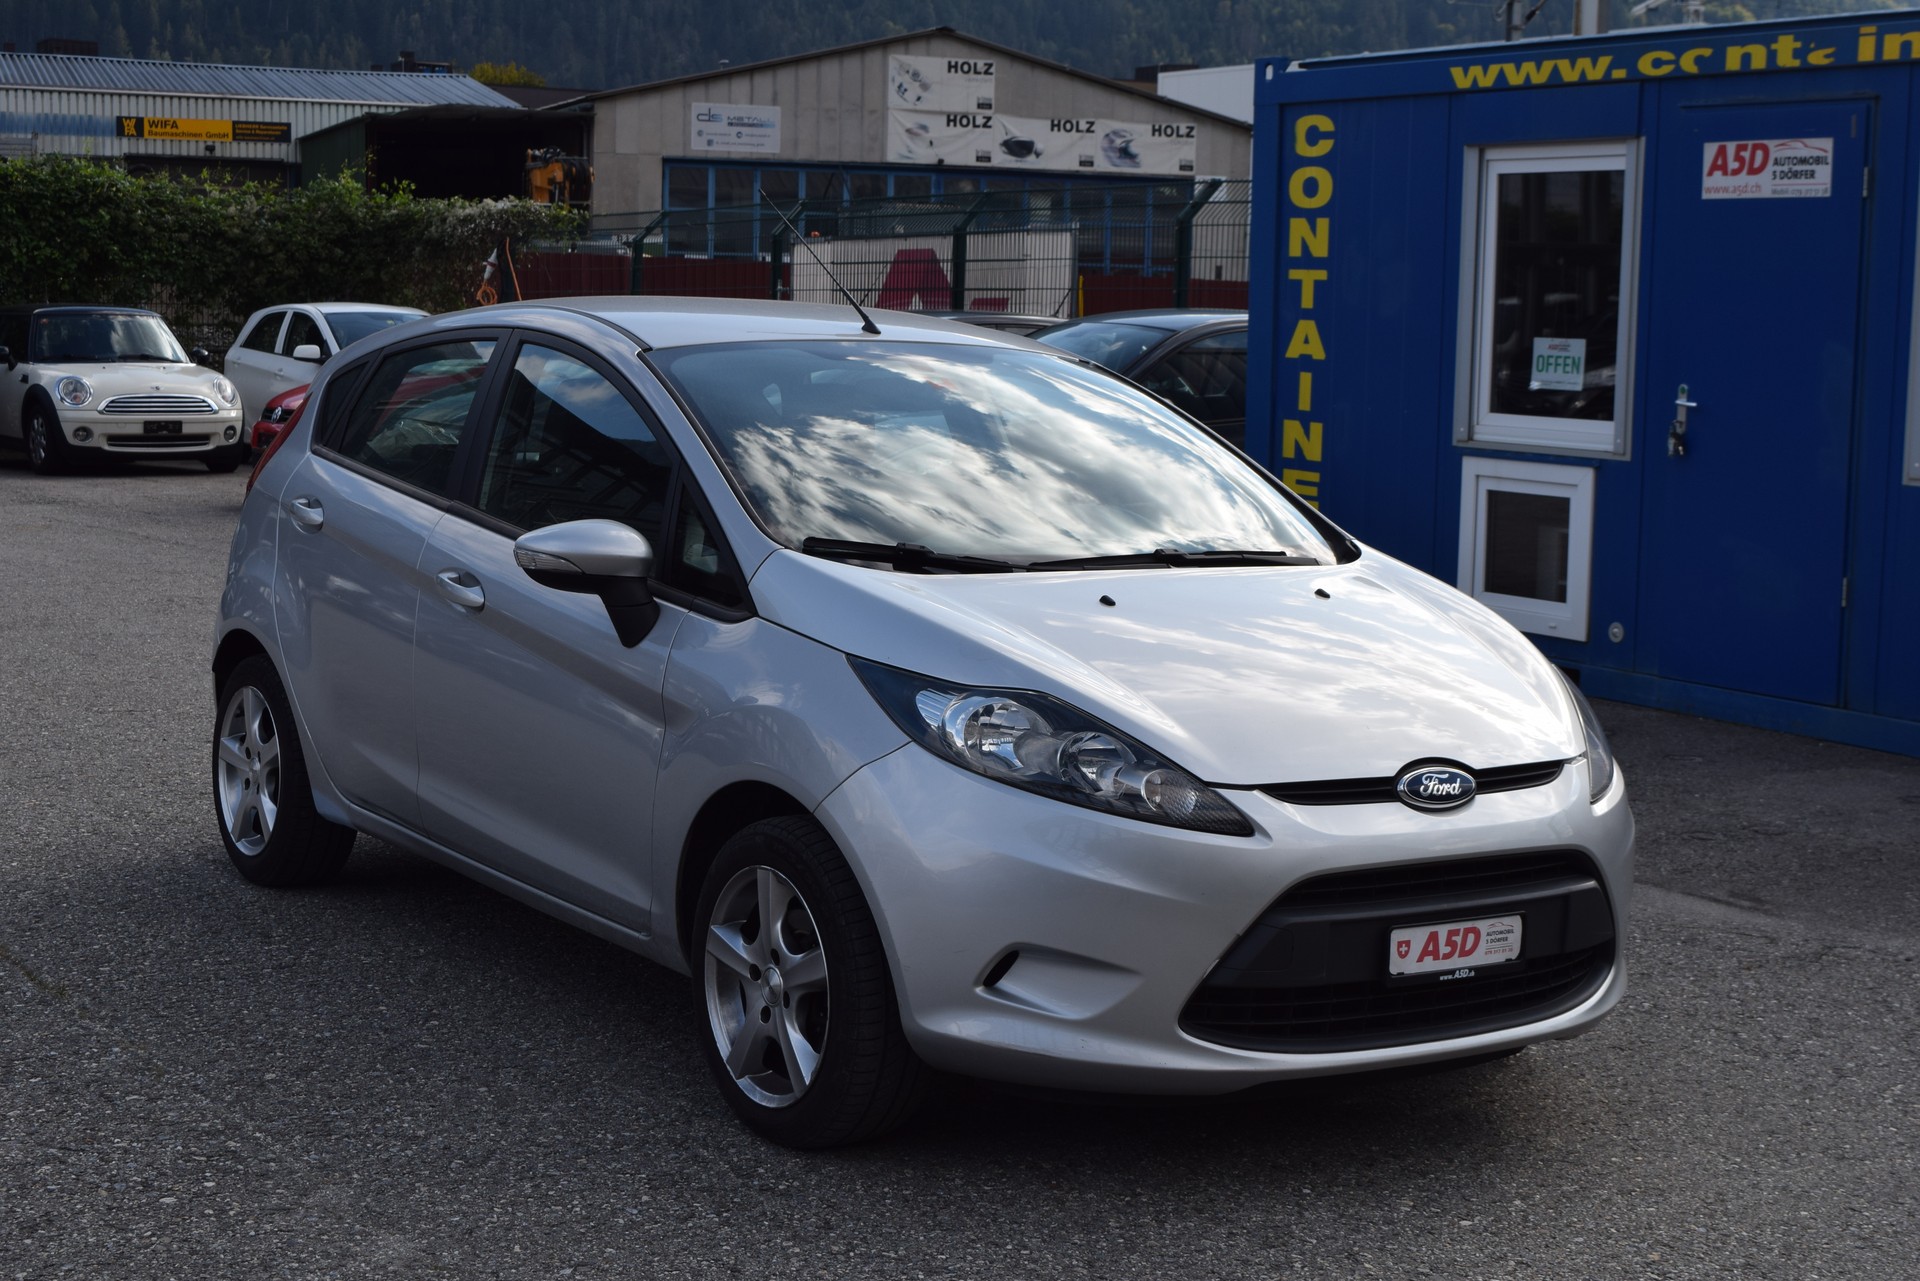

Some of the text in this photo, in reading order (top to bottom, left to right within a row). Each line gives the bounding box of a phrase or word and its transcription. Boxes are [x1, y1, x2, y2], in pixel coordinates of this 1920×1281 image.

[947, 61, 994, 75] HOLZ
[148, 119, 179, 129] WIFA
[946, 114, 993, 128] HOLZ
[1050, 119, 1096, 133] HOLZ
[148, 129, 203, 138] Baumaschinen
[205, 131, 229, 139] GmbH
[1151, 124, 1195, 138] HOLZ
[1706, 142, 1770, 177] A5D
[1772, 155, 1829, 167] AUTOMOBIL
[1779, 167, 1816, 180] DÖRFER
[1536, 354, 1581, 374] OFFEN
[1420, 773, 1461, 797] Ford
[1486, 929, 1515, 937] AUTOMOBIL
[1416, 926, 1481, 963] A5D
[1440, 969, 1475, 981] www.A5D.ch
